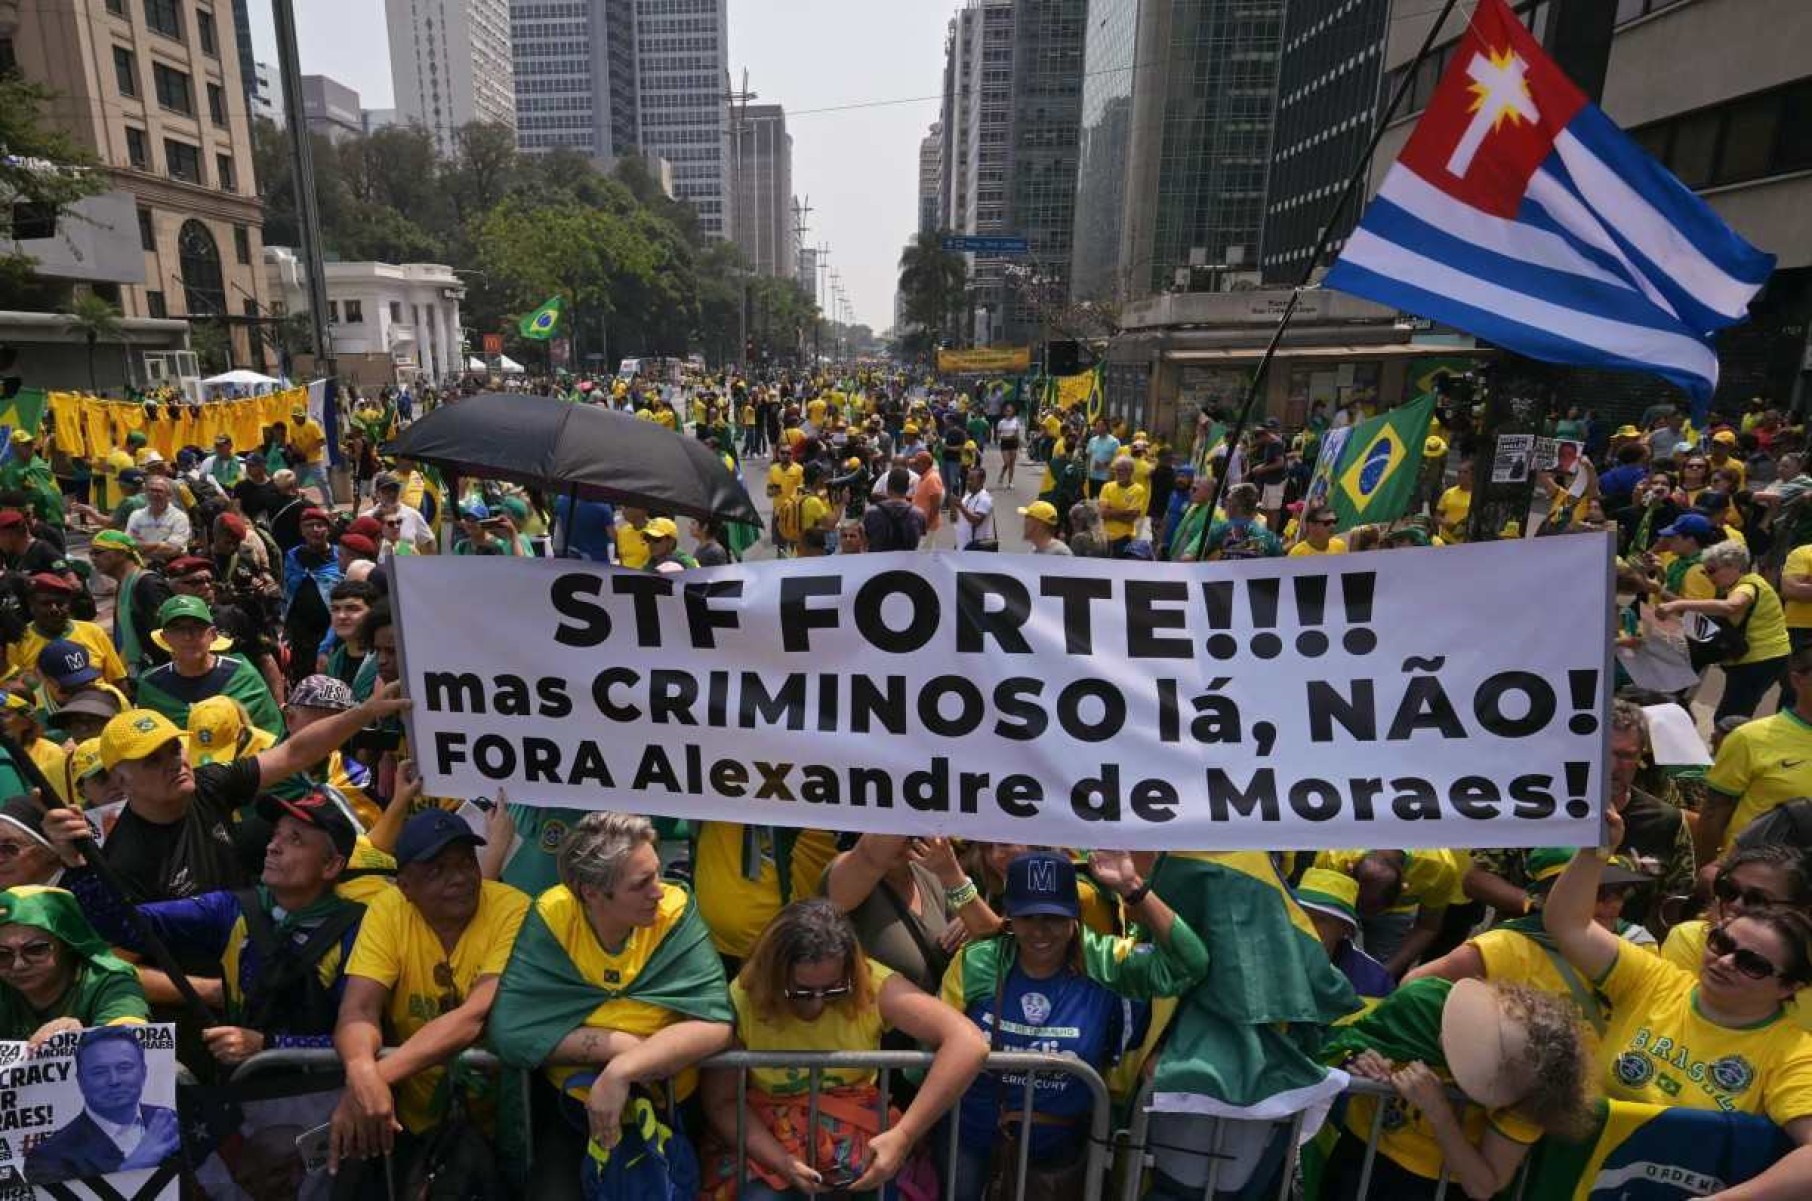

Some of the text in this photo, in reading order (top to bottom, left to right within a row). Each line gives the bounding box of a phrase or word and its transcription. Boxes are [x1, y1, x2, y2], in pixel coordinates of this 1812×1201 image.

[551, 569, 1378, 660] STF FORTE!!!!
[424, 655, 1599, 757] mas CRIMINOSO lá, NÃO!
[435, 732, 1591, 823] FORA Alexandre de Moraes!
[1027, 859, 1056, 893] M
[0, 1105, 54, 1131] AES!
